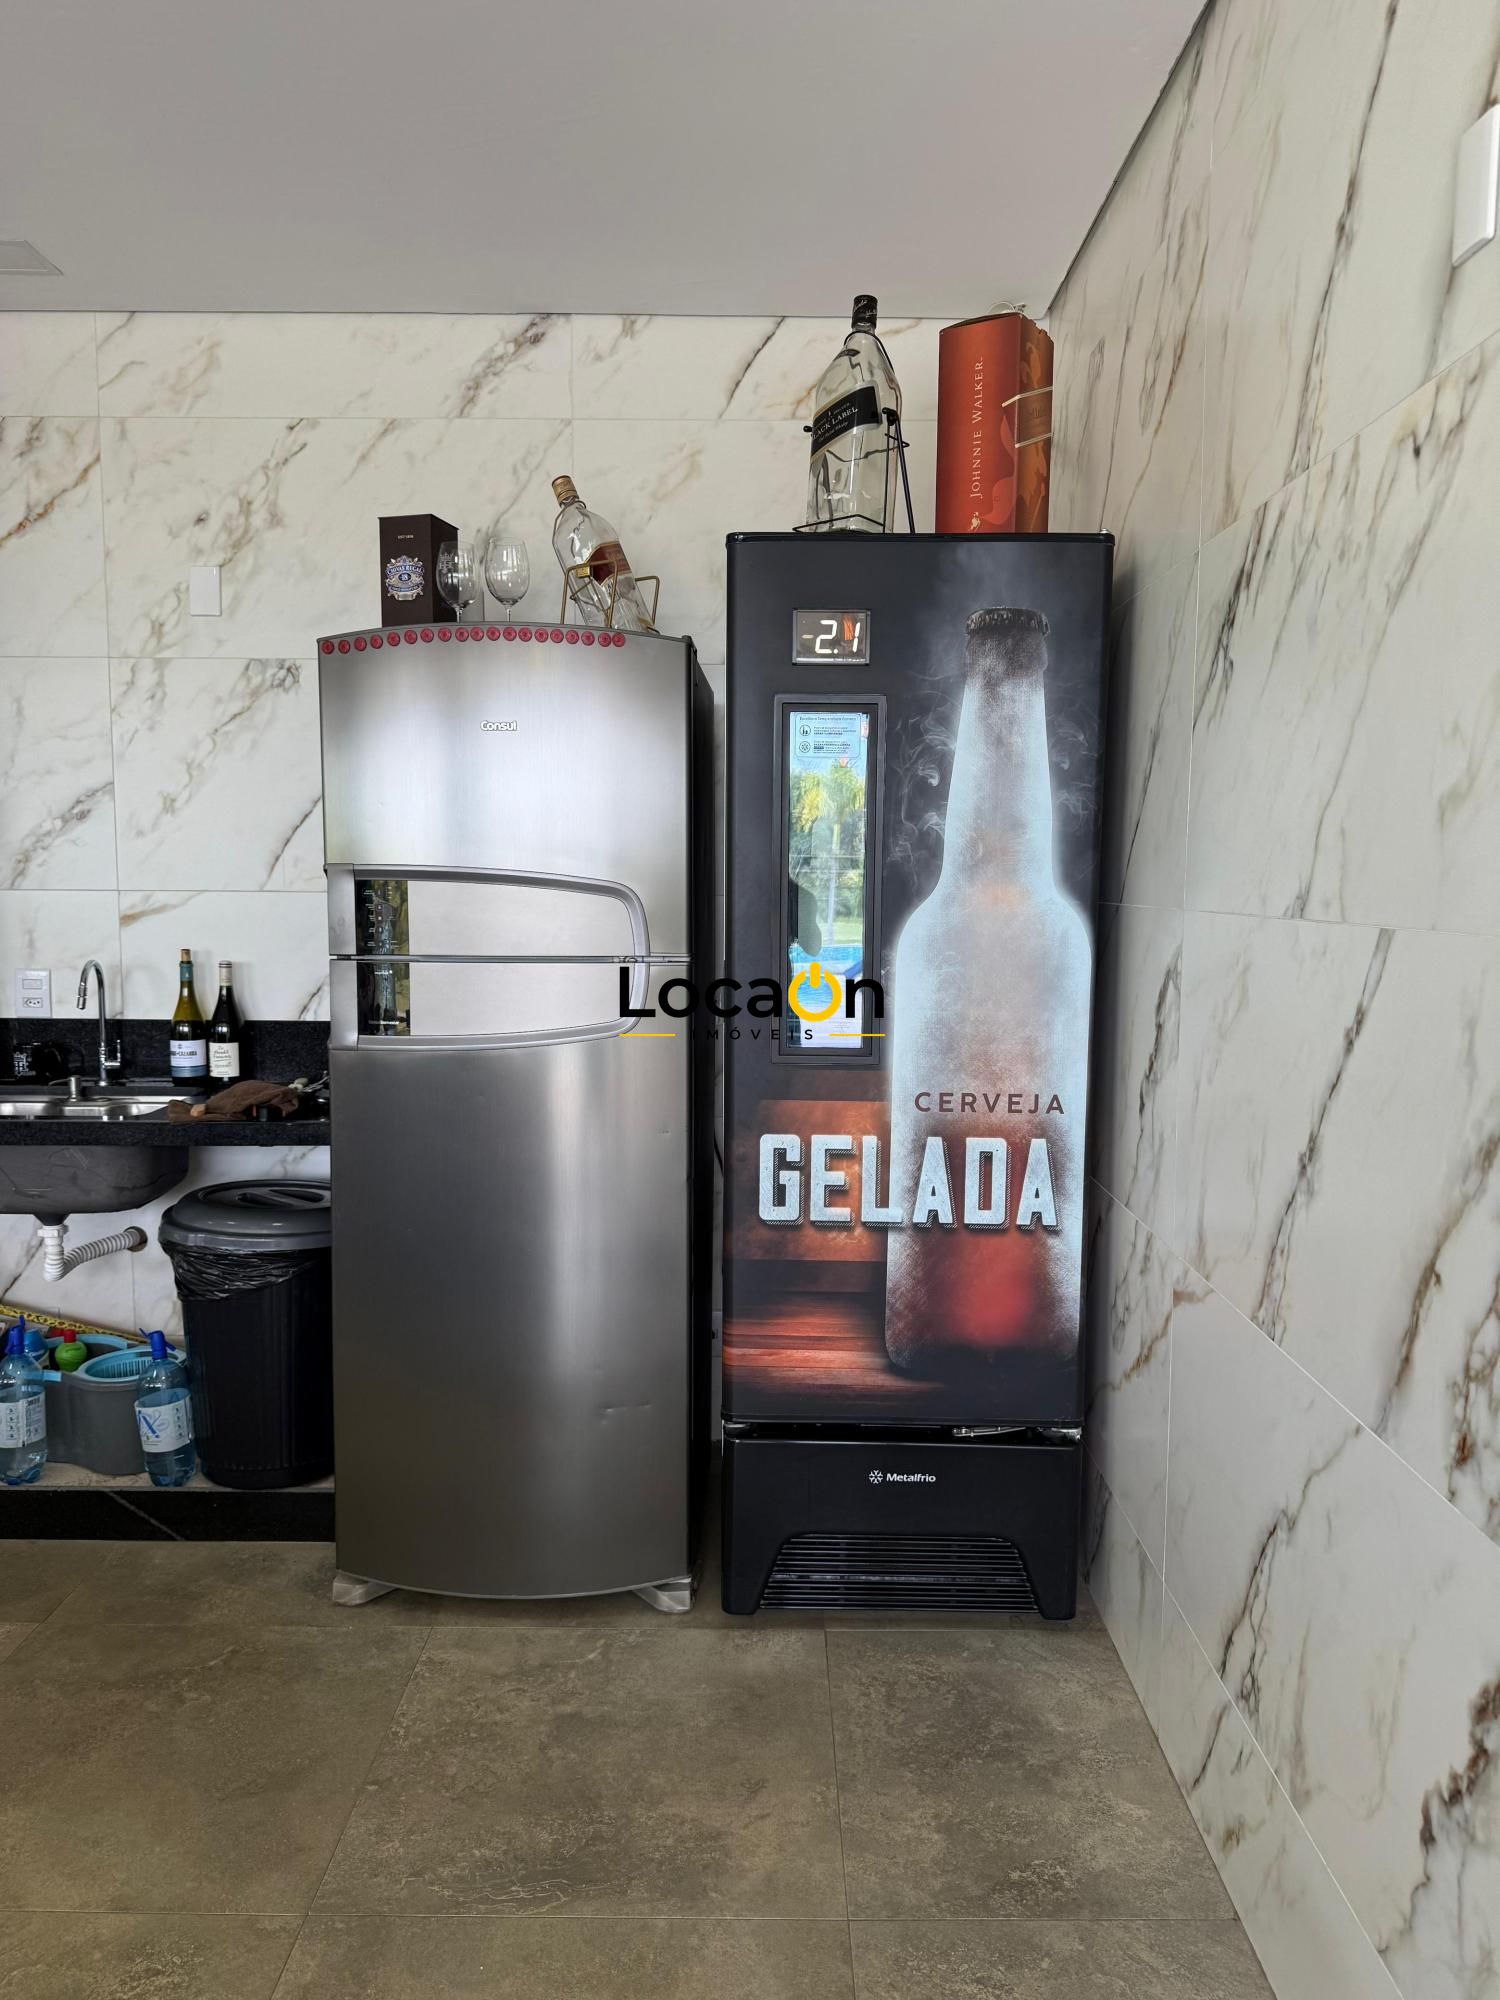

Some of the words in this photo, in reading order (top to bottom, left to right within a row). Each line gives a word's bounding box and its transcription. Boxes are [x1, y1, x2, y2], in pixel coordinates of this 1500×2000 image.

[972, 361, 984, 424] WALKER
[832, 406, 858, 425] LABEL
[970, 430, 983, 499] JOHNNIE
[480, 720, 517, 731] Consul
[914, 1091, 1065, 1115] CERVEJA
[758, 1133, 1062, 1228] GELADA
[886, 1472, 937, 1483] Metalfrio
